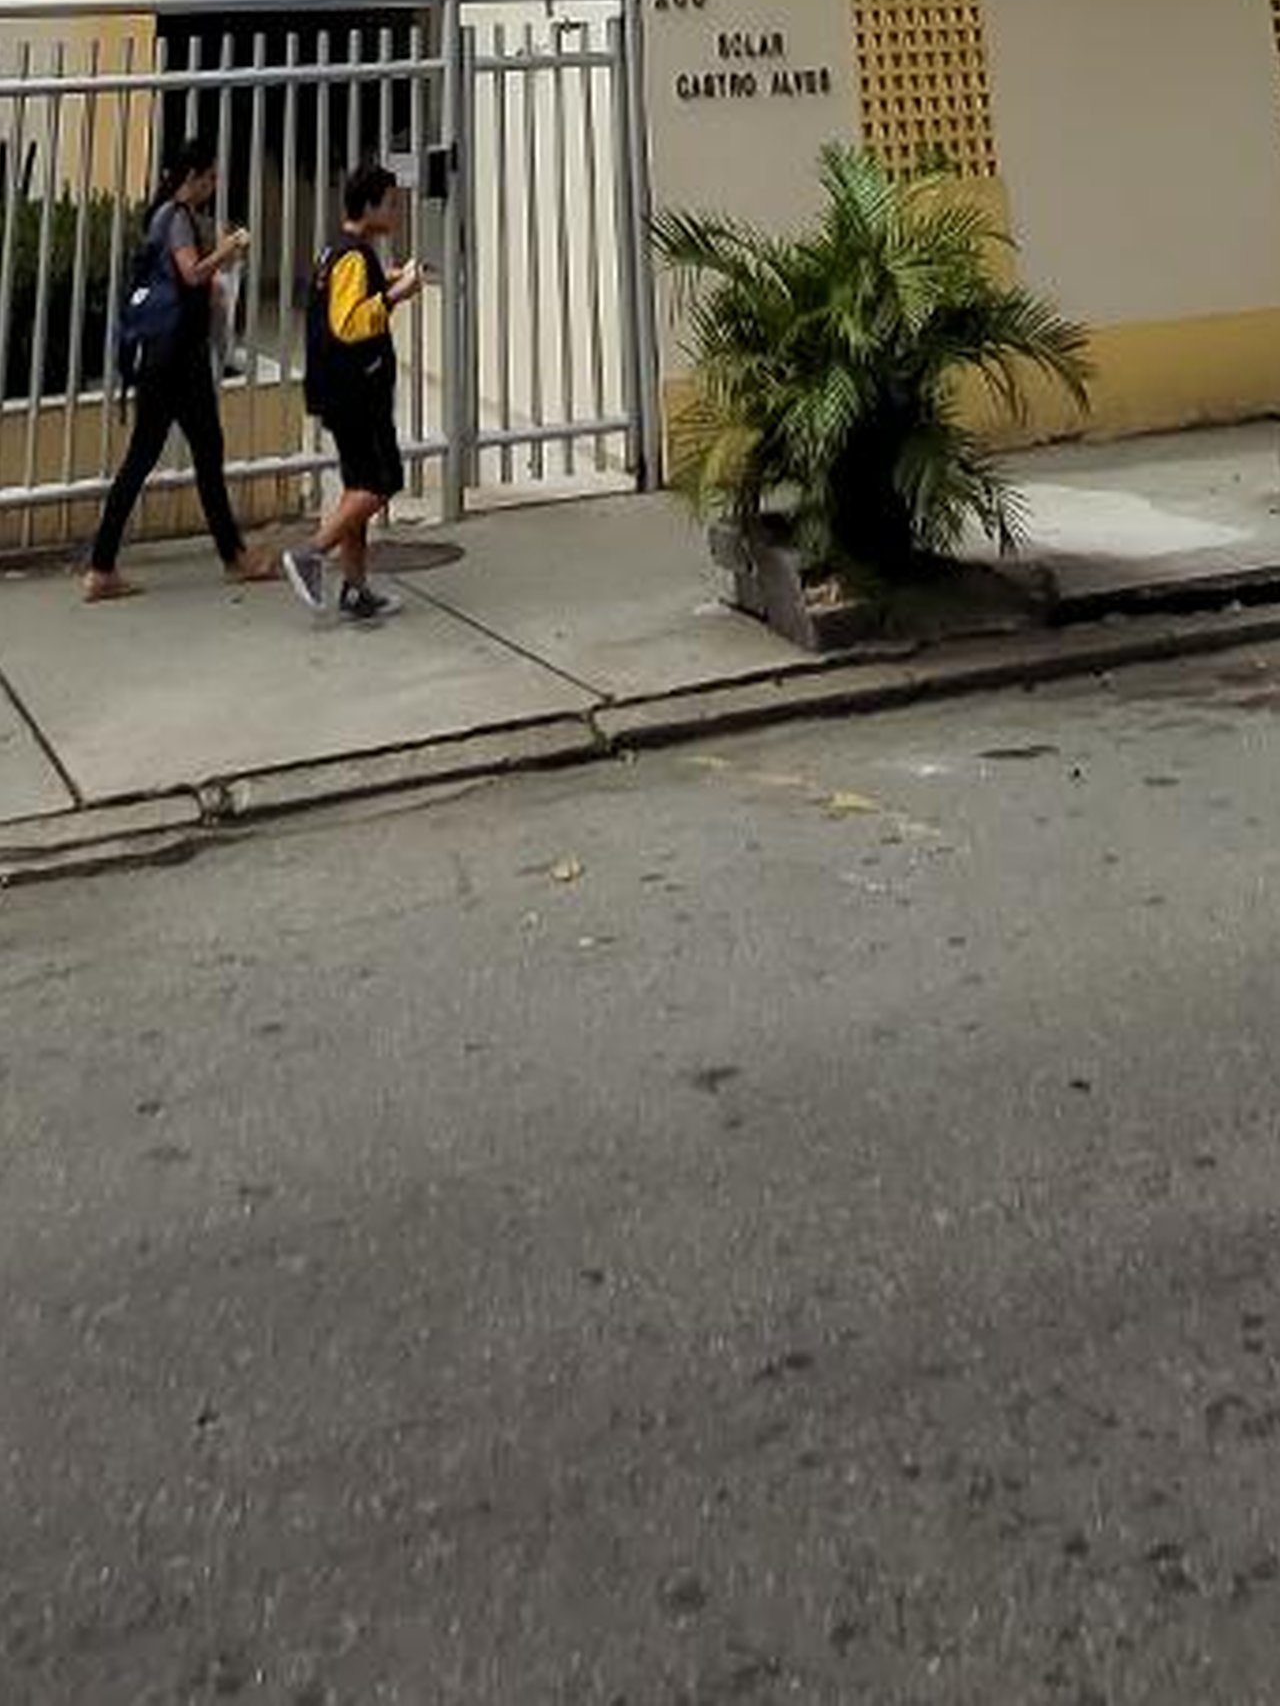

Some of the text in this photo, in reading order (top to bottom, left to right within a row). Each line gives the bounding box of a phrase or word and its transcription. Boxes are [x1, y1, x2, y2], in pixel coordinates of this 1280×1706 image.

[717, 32, 784, 59] SOLAR
[676, 67, 831, 100] CASTRO ALVES
